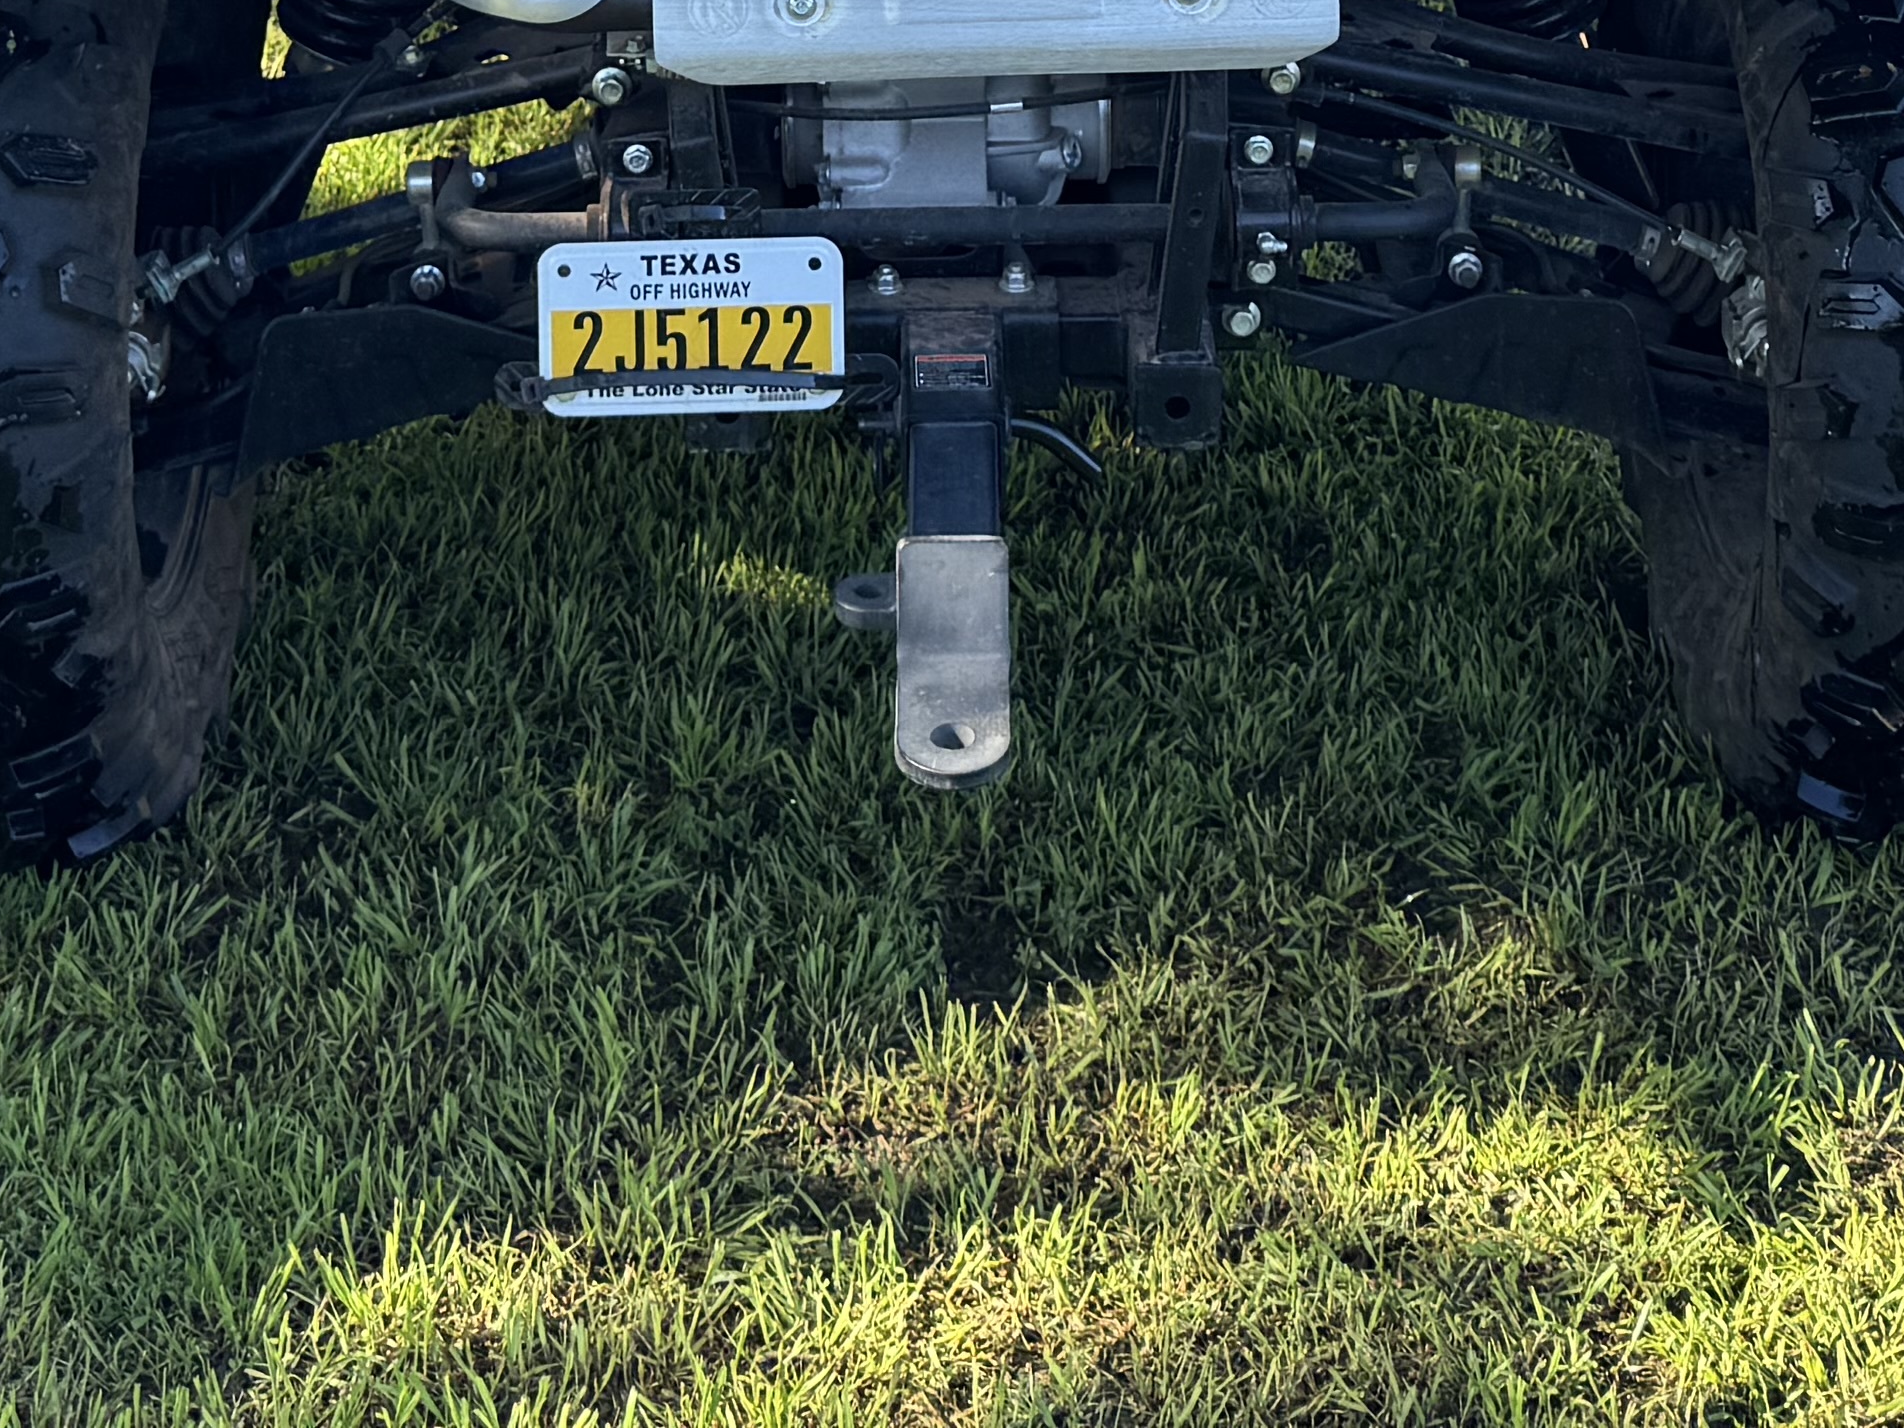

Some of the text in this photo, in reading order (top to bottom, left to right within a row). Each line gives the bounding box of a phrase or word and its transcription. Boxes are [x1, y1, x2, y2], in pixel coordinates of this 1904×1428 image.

[640, 252, 741, 277] TEXAS
[629, 281, 752, 301] OFF HIGHWAY
[573, 305, 814, 376] 2J5122
